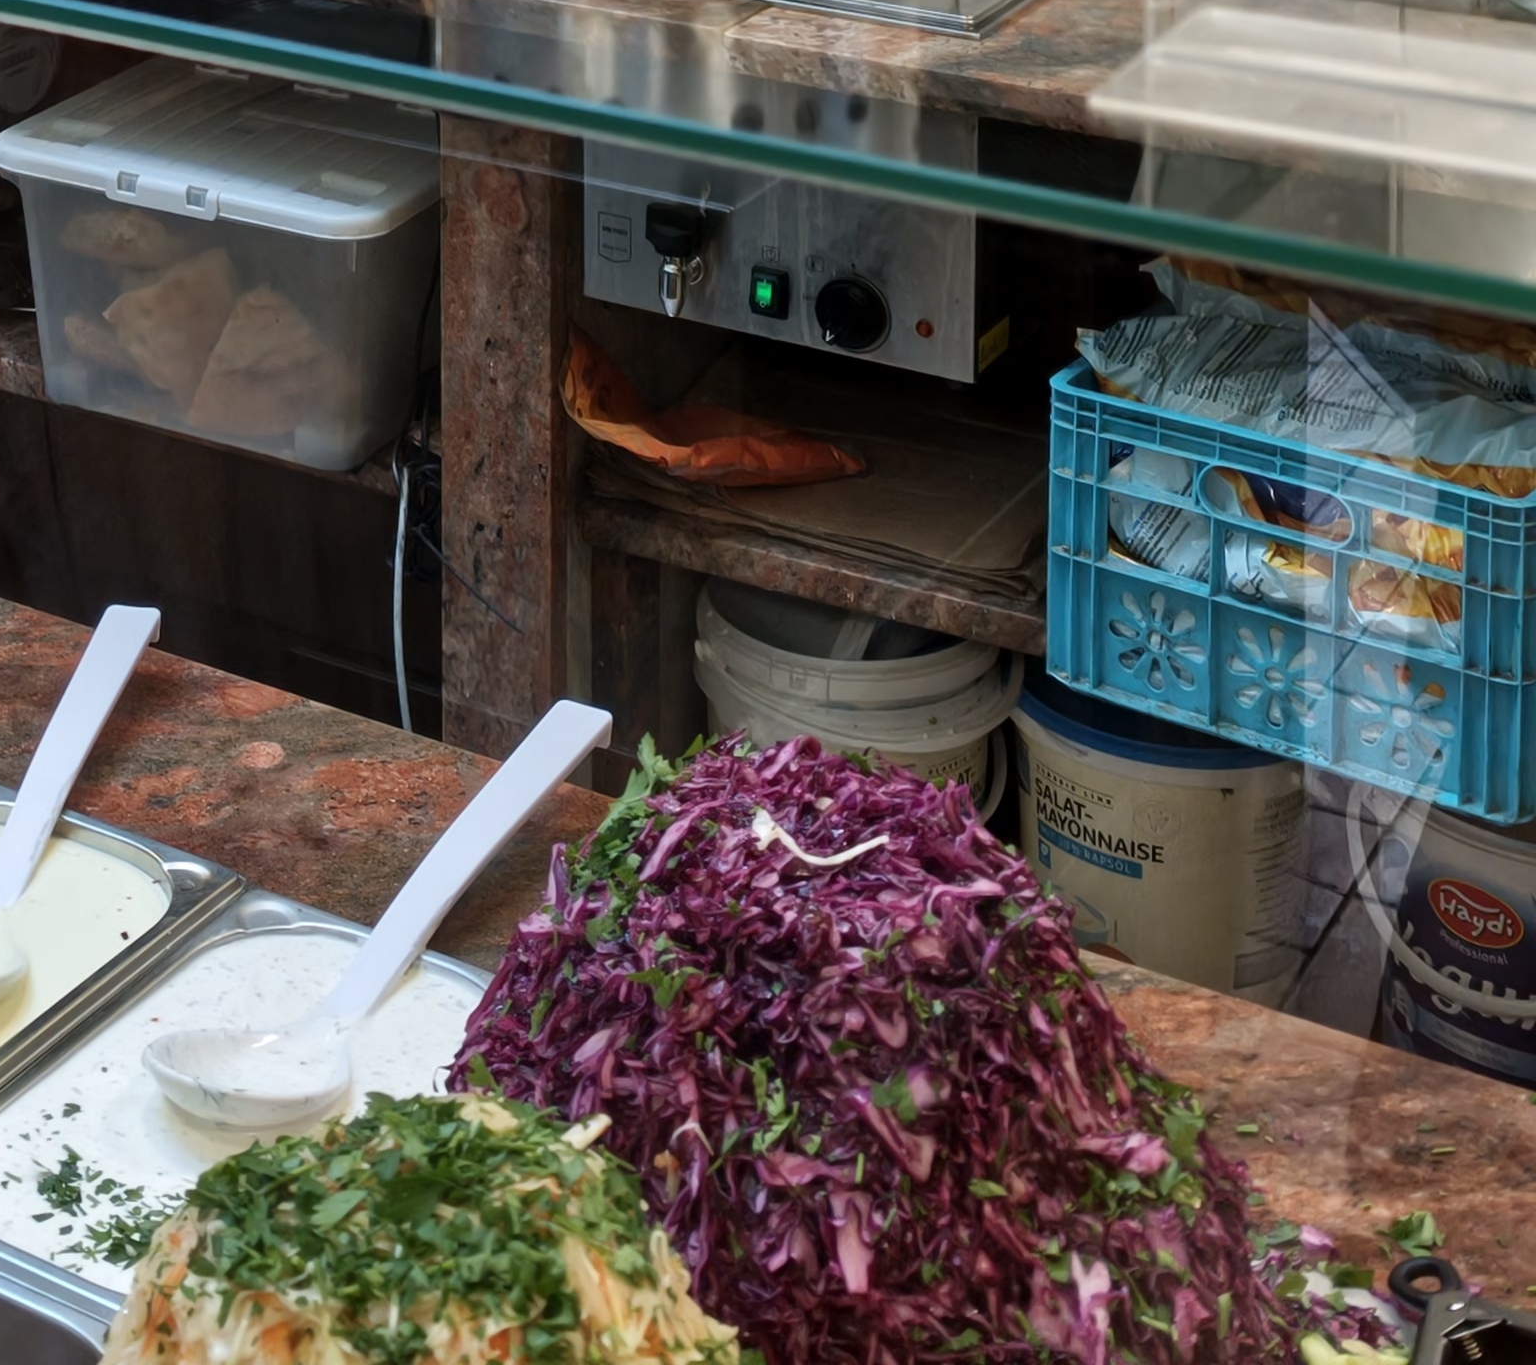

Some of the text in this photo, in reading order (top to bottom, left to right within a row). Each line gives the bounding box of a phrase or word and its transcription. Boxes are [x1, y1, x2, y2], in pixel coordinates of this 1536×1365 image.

[1035, 777, 1094, 821] SALAT-
[1036, 797, 1165, 864] MAYONNAISE
[1439, 889, 1514, 937] Haydi
[1439, 927, 1509, 965] Professional
